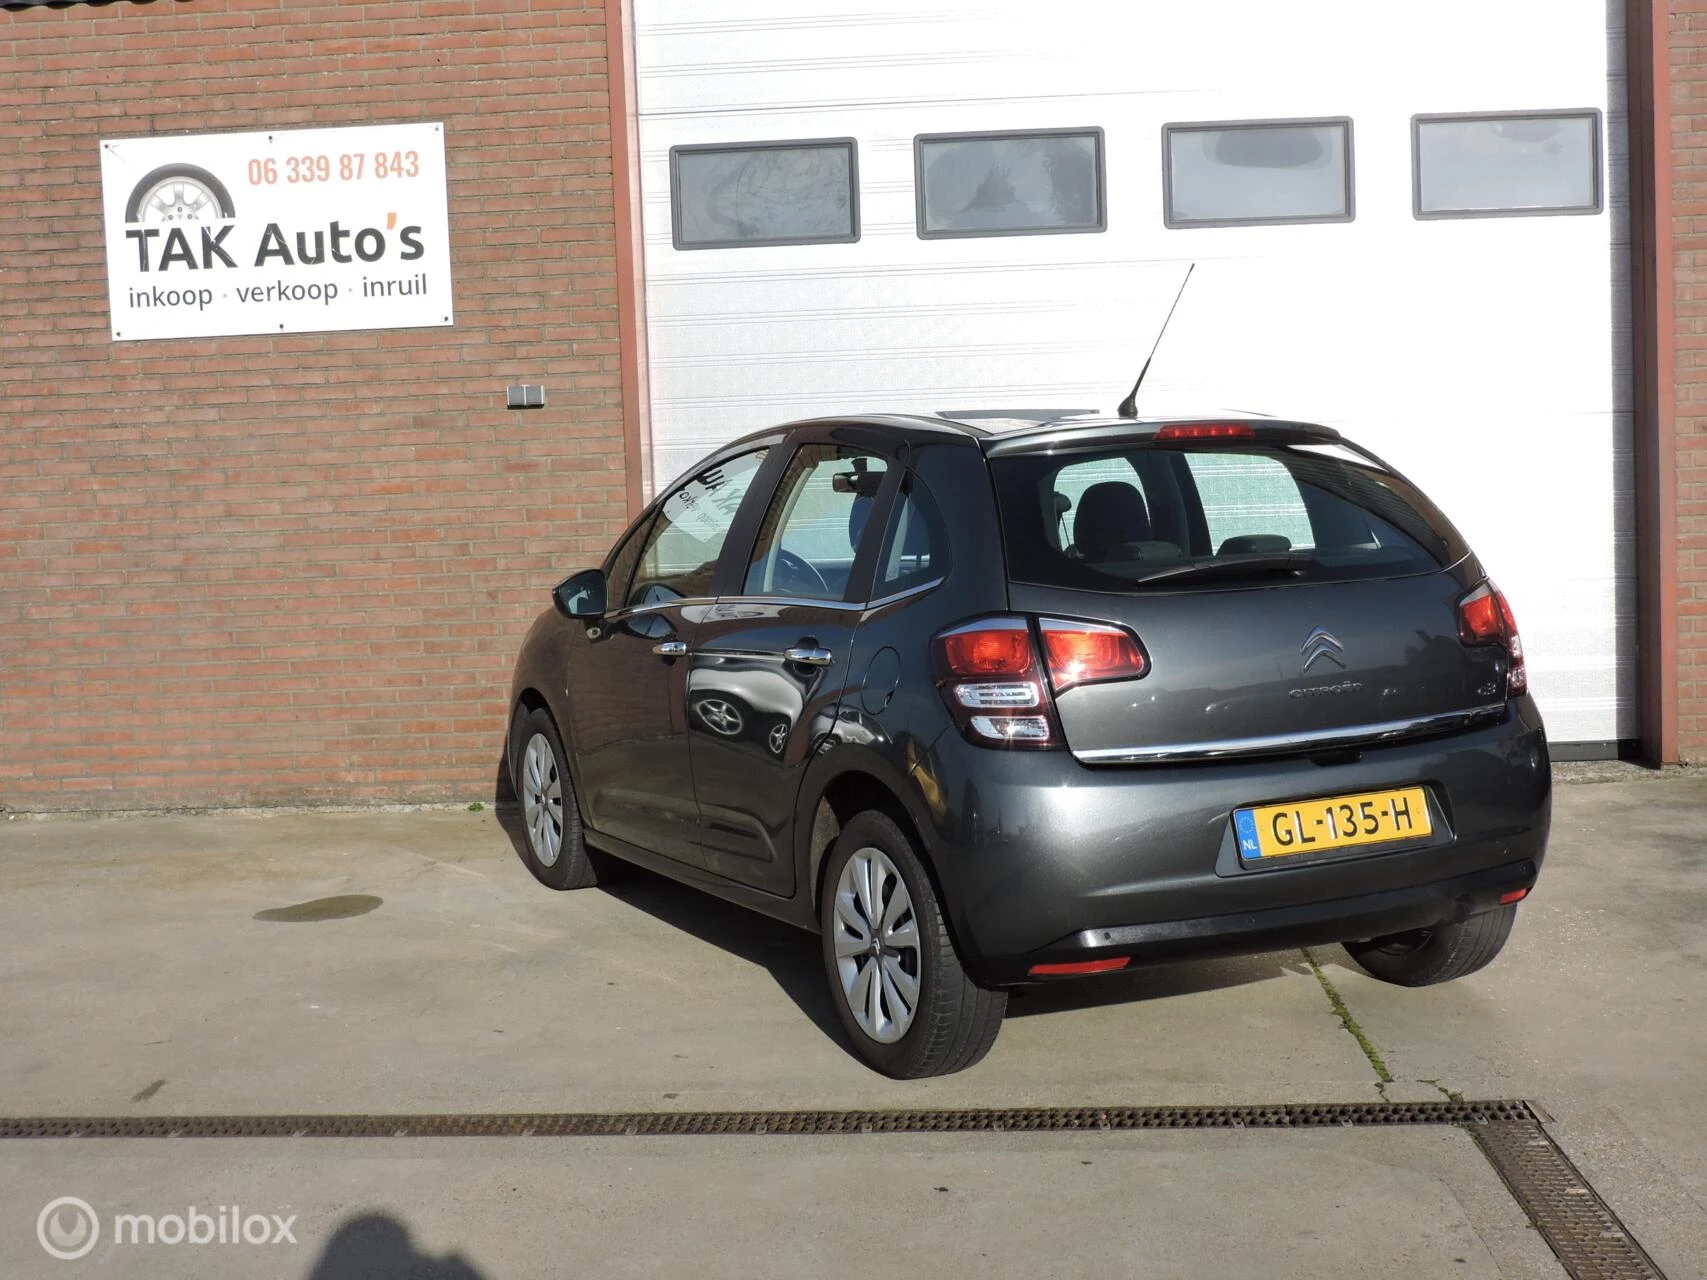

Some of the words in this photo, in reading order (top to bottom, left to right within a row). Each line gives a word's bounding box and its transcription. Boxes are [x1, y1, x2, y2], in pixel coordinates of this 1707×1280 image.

[248, 158, 278, 185] 06
[286, 155, 330, 183] 339
[339, 153, 366, 181] 87
[374, 150, 420, 179] 843
[125, 224, 238, 272] TAK
[254, 212, 425, 267] Auto's
[129, 286, 213, 311] inkoop
[236, 280, 338, 305] verkoop
[362, 273, 428, 297] inruil
[1272, 797, 1413, 847] GL-135-H
[1242, 839, 1258, 851] NL
